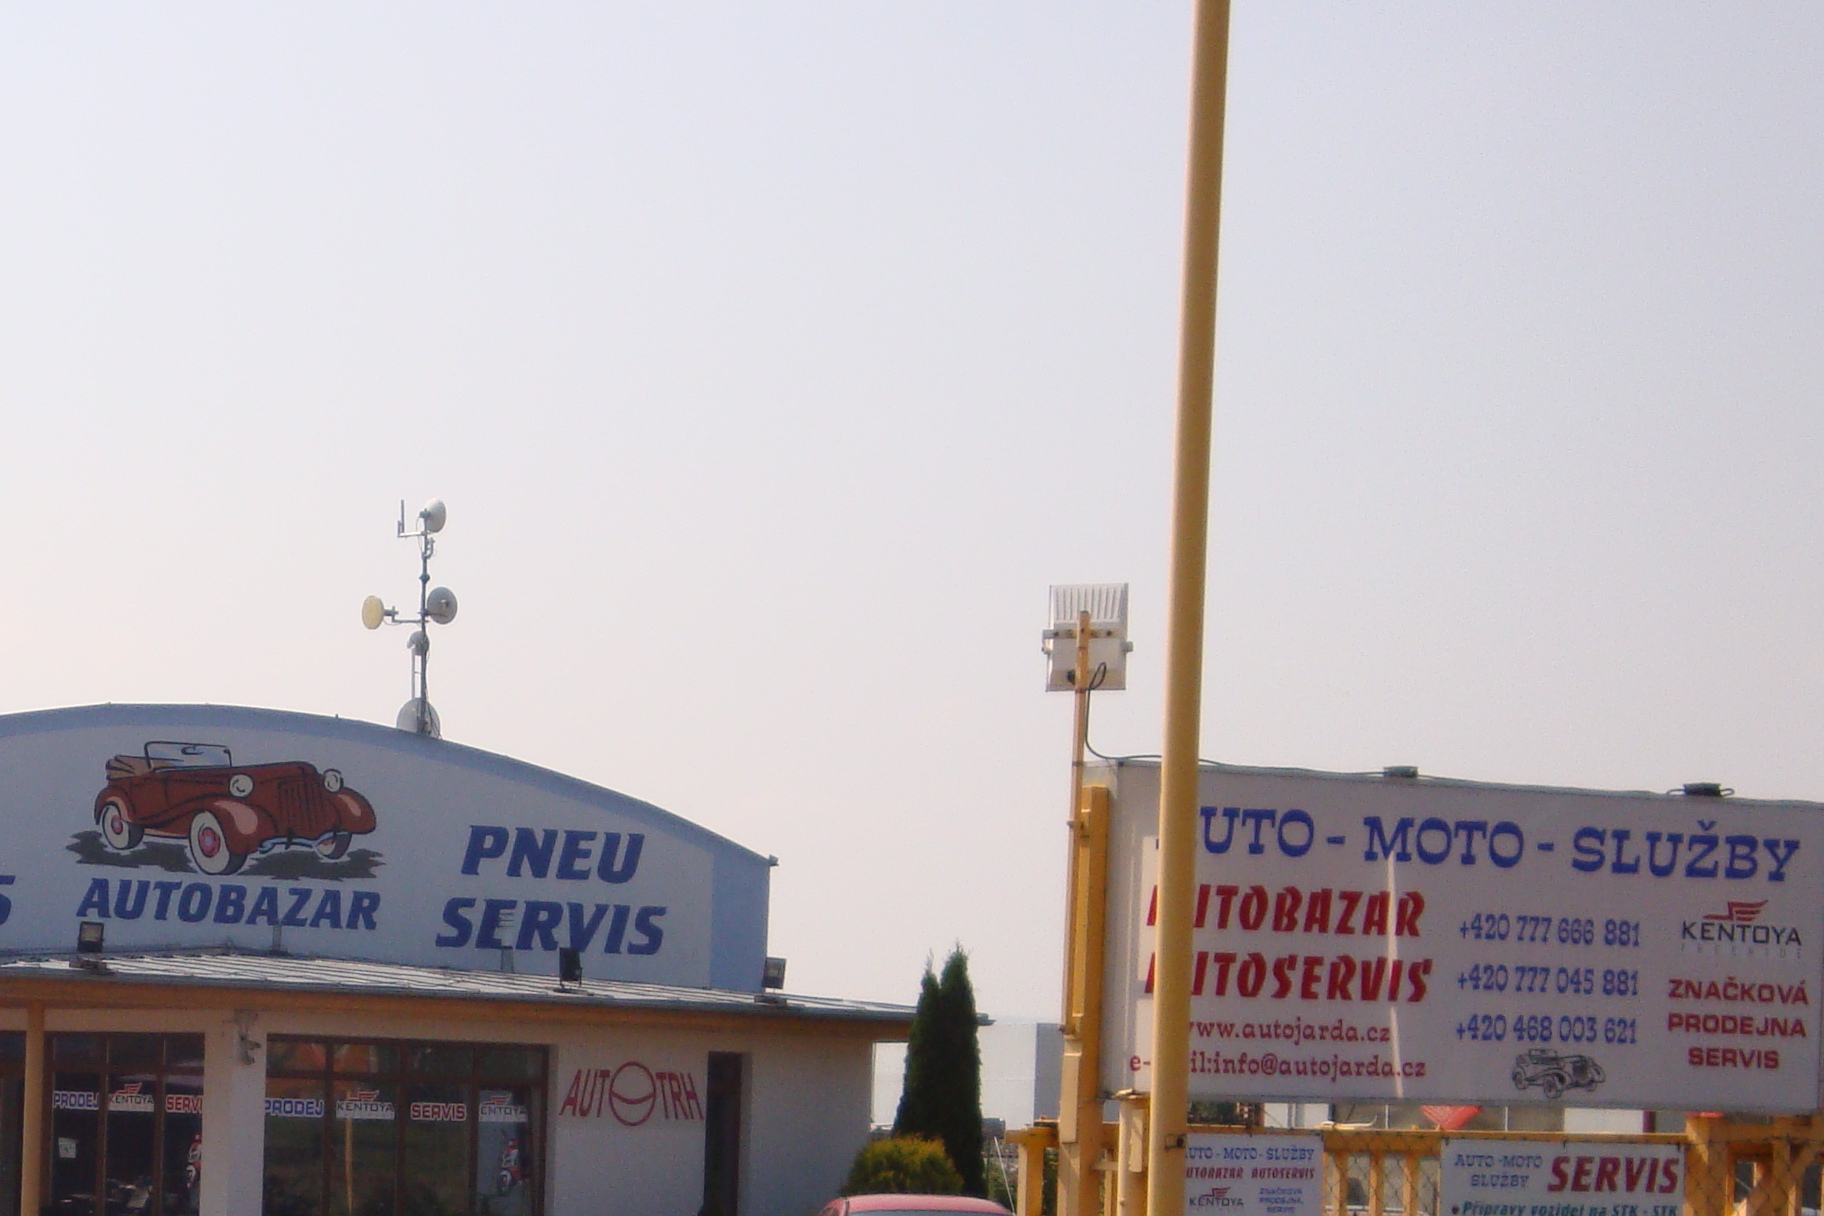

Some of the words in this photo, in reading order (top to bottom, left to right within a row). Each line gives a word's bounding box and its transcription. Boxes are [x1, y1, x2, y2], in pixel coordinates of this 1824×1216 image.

[461, 825, 645, 884] PNEU
[1174, 806, 1315, 858] UTO
[1363, 816, 1524, 869] MOTO
[1571, 819, 1801, 882] SLUŽBY
[77, 877, 381, 930] AUTOBAZAR
[436, 898, 668, 955] SERVIS
[1460, 913, 1510, 941] +420
[1517, 915, 1552, 943] 777
[1557, 918, 1594, 945] 666
[1604, 918, 1640, 947] 881
[1682, 920, 1802, 946] KENTOYA
[1457, 964, 1509, 992] +420
[1515, 966, 1551, 993] 777
[1556, 968, 1594, 995] 045
[1603, 970, 1639, 997] 881
[1668, 976, 1809, 1005] ZNAČKOVÁ
[1456, 1014, 1506, 1042] +420
[1513, 1015, 1553, 1043] 468
[1559, 1016, 1597, 1043] 003
[1604, 1018, 1638, 1044] 621
[1668, 1012, 1806, 1038] PRODEJNA
[1130, 1052, 1425, 1082] e-il:info@autojarda.cz
[1688, 1046, 1780, 1069] SERVIS
[53, 1092, 100, 1109] PRODEJ
[265, 1098, 325, 1117] PRODEJ
[337, 1101, 394, 1113] KENTOYA
[411, 1103, 467, 1121] SERVIS
[1185, 1147, 1213, 1160] UTO
[1223, 1147, 1257, 1160] MOTO
[1266, 1145, 1314, 1160] SLUŽBY
[1454, 1154, 1494, 1167] AUTO
[1186, 1167, 1243, 1179] UTOBAZAR
[1471, 1171, 1529, 1188] SLUŽBY
[1547, 1156, 1679, 1193] SERVIS
[1189, 1196, 1244, 1207] KENTOYA
